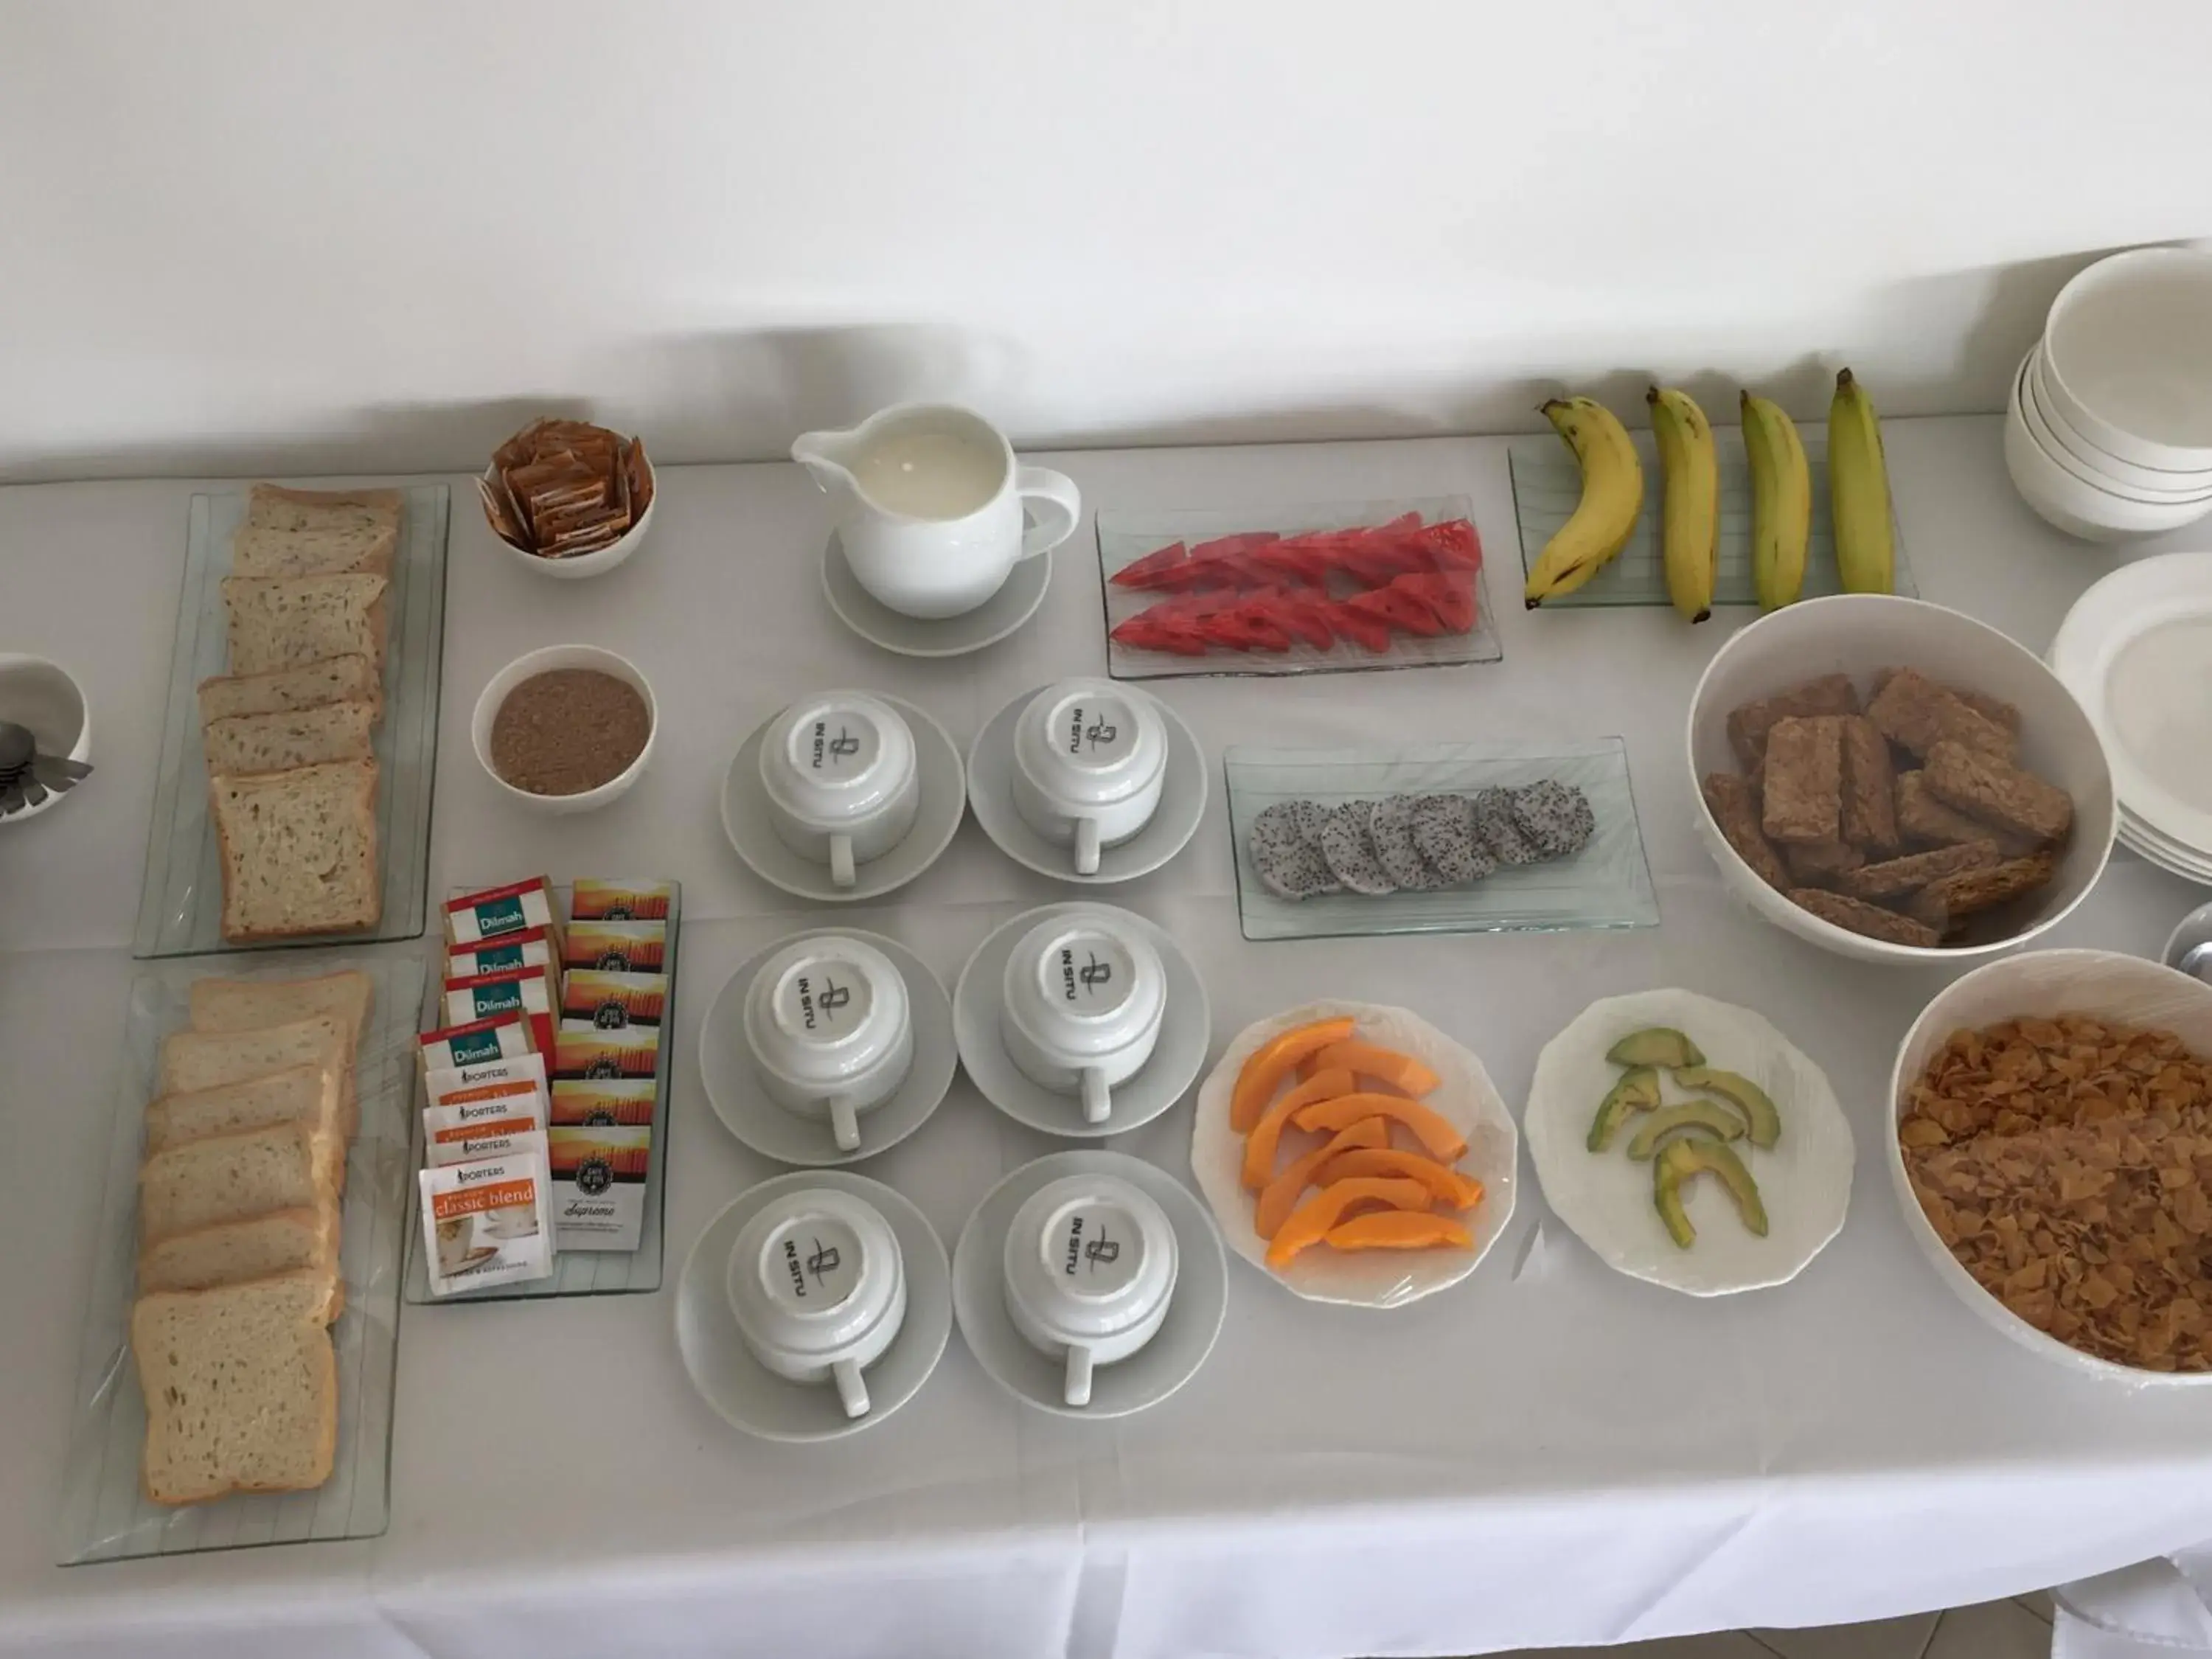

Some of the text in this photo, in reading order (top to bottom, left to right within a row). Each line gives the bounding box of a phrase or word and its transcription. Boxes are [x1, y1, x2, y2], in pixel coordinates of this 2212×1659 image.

[813, 722, 825, 768] IN SITU
[1071, 709, 1082, 754] IN SITU
[480, 911, 523, 930] Dilmah
[1062, 949, 1077, 1001] IN SITU
[476, 995, 520, 1012] Dilmah
[798, 978, 816, 1029] IN SITU
[454, 1043, 498, 1062] Dilmah
[465, 1105, 508, 1119] PORTERS
[462, 1166, 505, 1180] PORTERS
[436, 1196, 485, 1216] classic
[489, 1181, 533, 1205] blend
[1066, 1217, 1083, 1275] IN SITU
[784, 1240, 807, 1297] IN SITU
